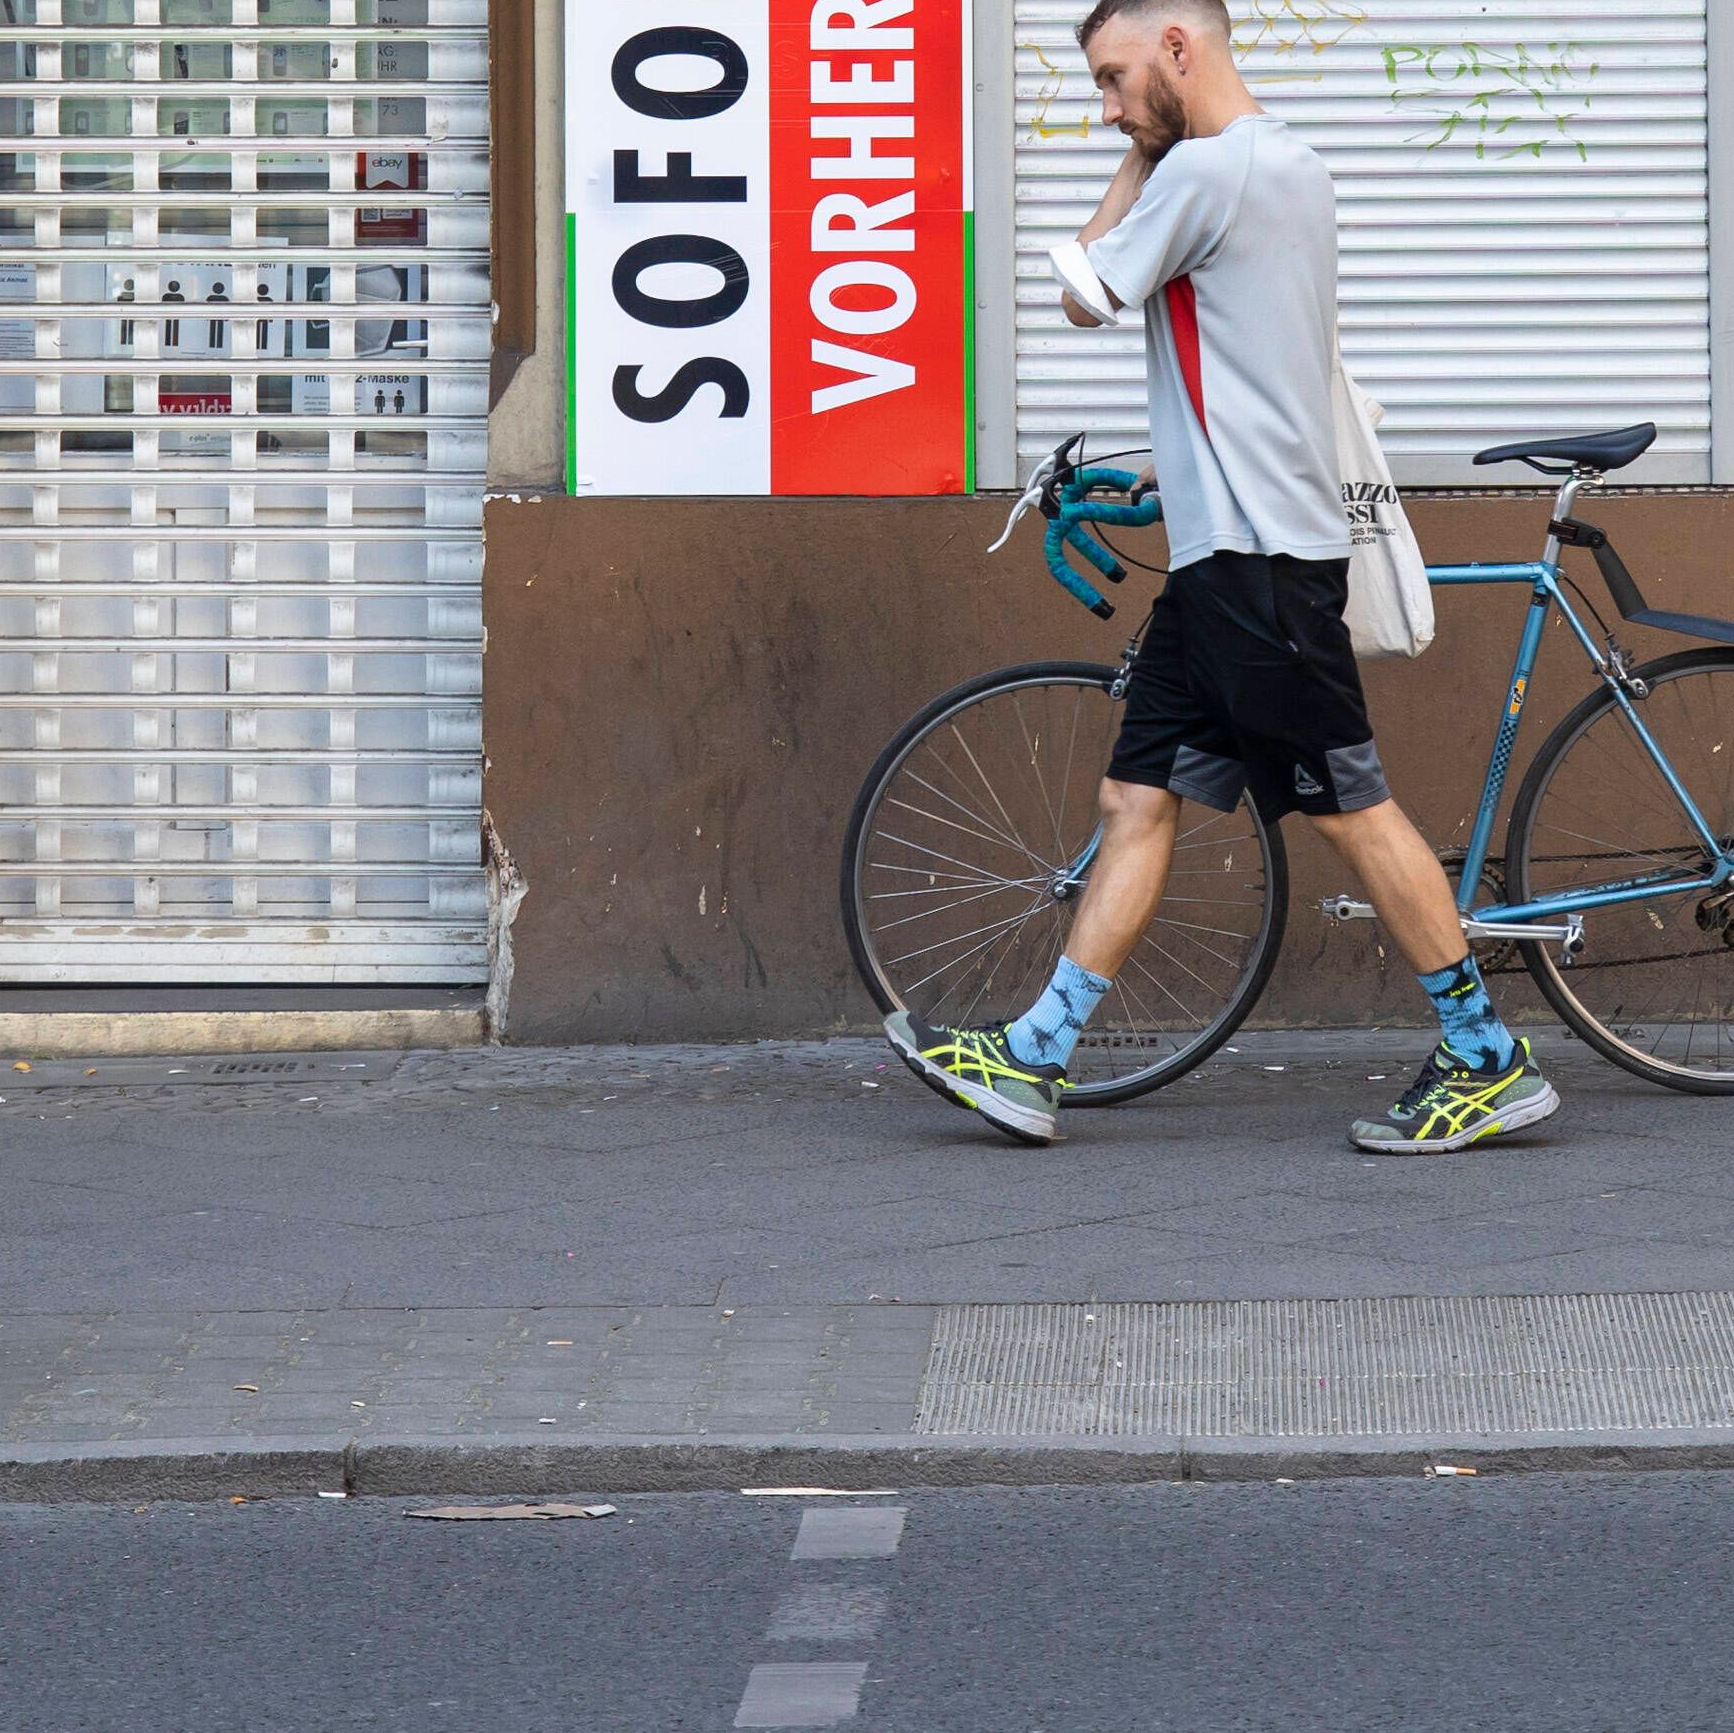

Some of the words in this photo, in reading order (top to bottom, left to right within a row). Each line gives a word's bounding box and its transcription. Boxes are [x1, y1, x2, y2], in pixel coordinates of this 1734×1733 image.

[372, 157, 402, 169] ebay
[355, 375, 409, 384] 2-Maske
[1341, 482, 1398, 505] azzo
[1343, 504, 1379, 525] SSI
[1351, 537, 1377, 546] ATION
